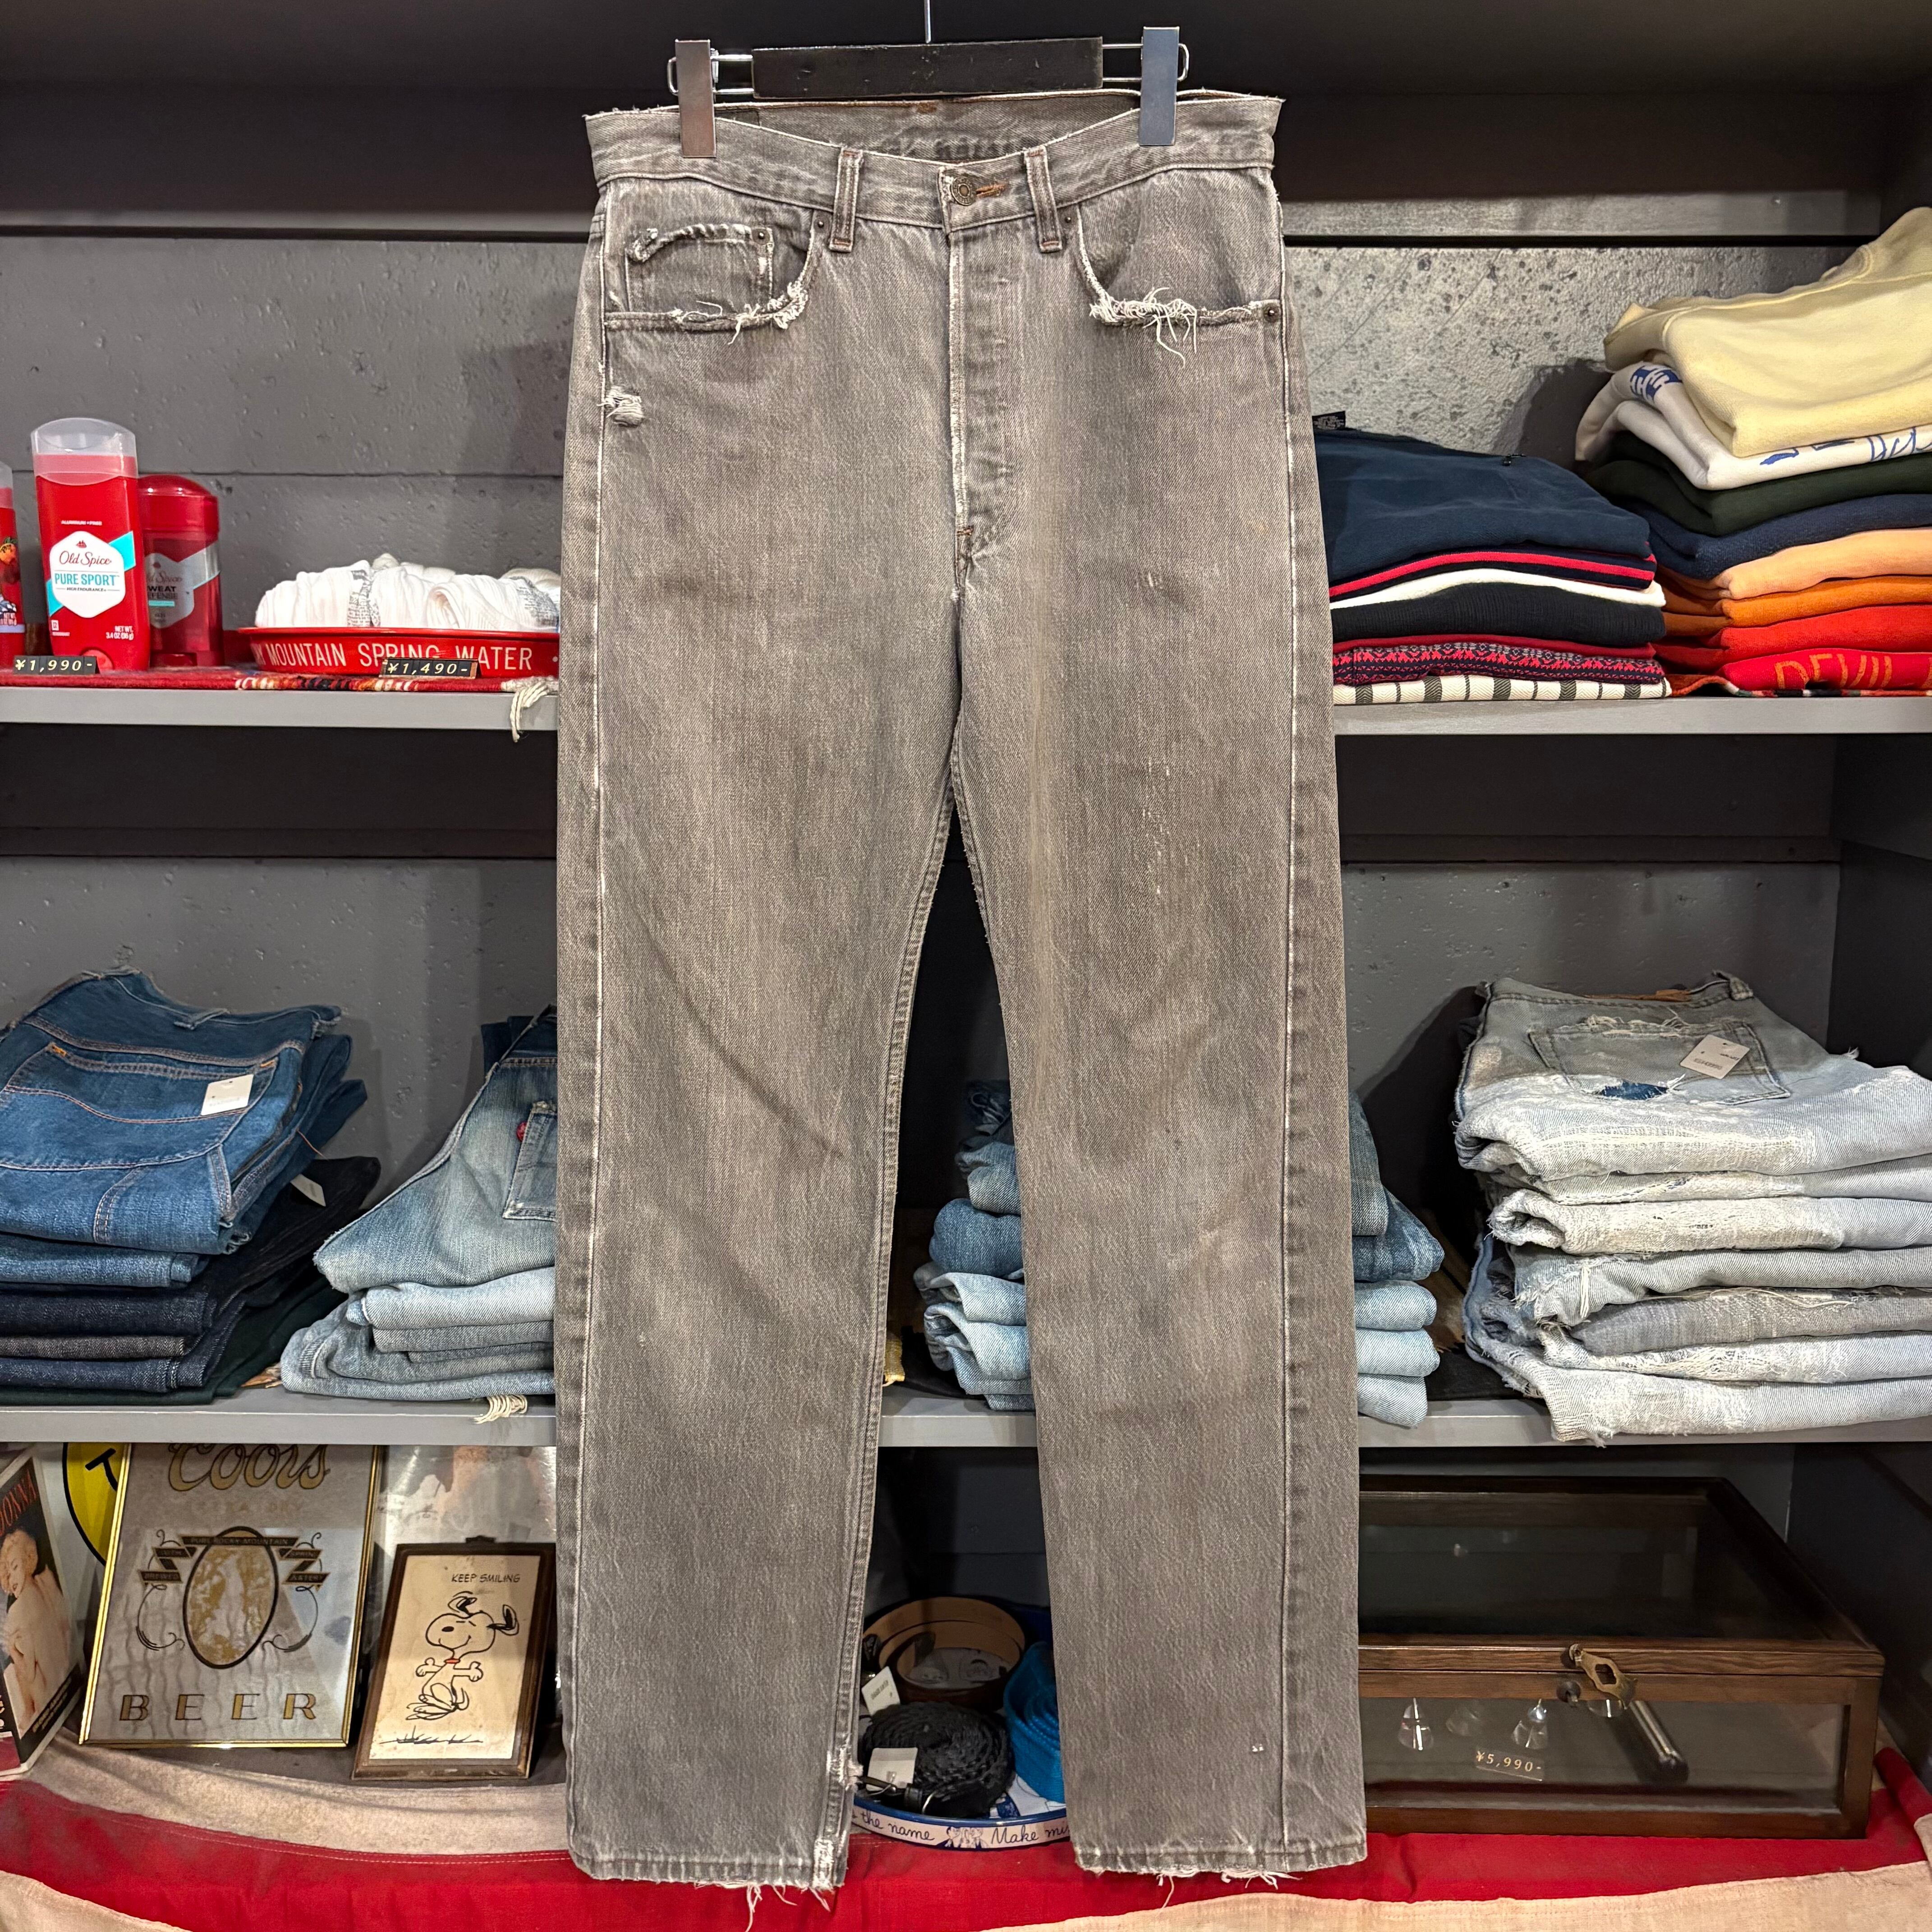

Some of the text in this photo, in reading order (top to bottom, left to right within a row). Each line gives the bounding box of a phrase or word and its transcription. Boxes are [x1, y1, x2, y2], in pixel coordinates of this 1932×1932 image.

[59, 550, 111, 567] Old Spice
[55, 573, 116, 586] PURE SPORT
[265, 643, 346, 667] MOUNTAIN
[455, 645, 533, 670] WATER
[168, 1443, 328, 1491] Coors
[451, 1573, 520, 1582] KEEP SMILING
[119, 1693, 316, 1720] BEER
[860, 1809, 883, 1829] the
[888, 1823, 935, 1840] name
[991, 1825, 1040, 1844] Make
